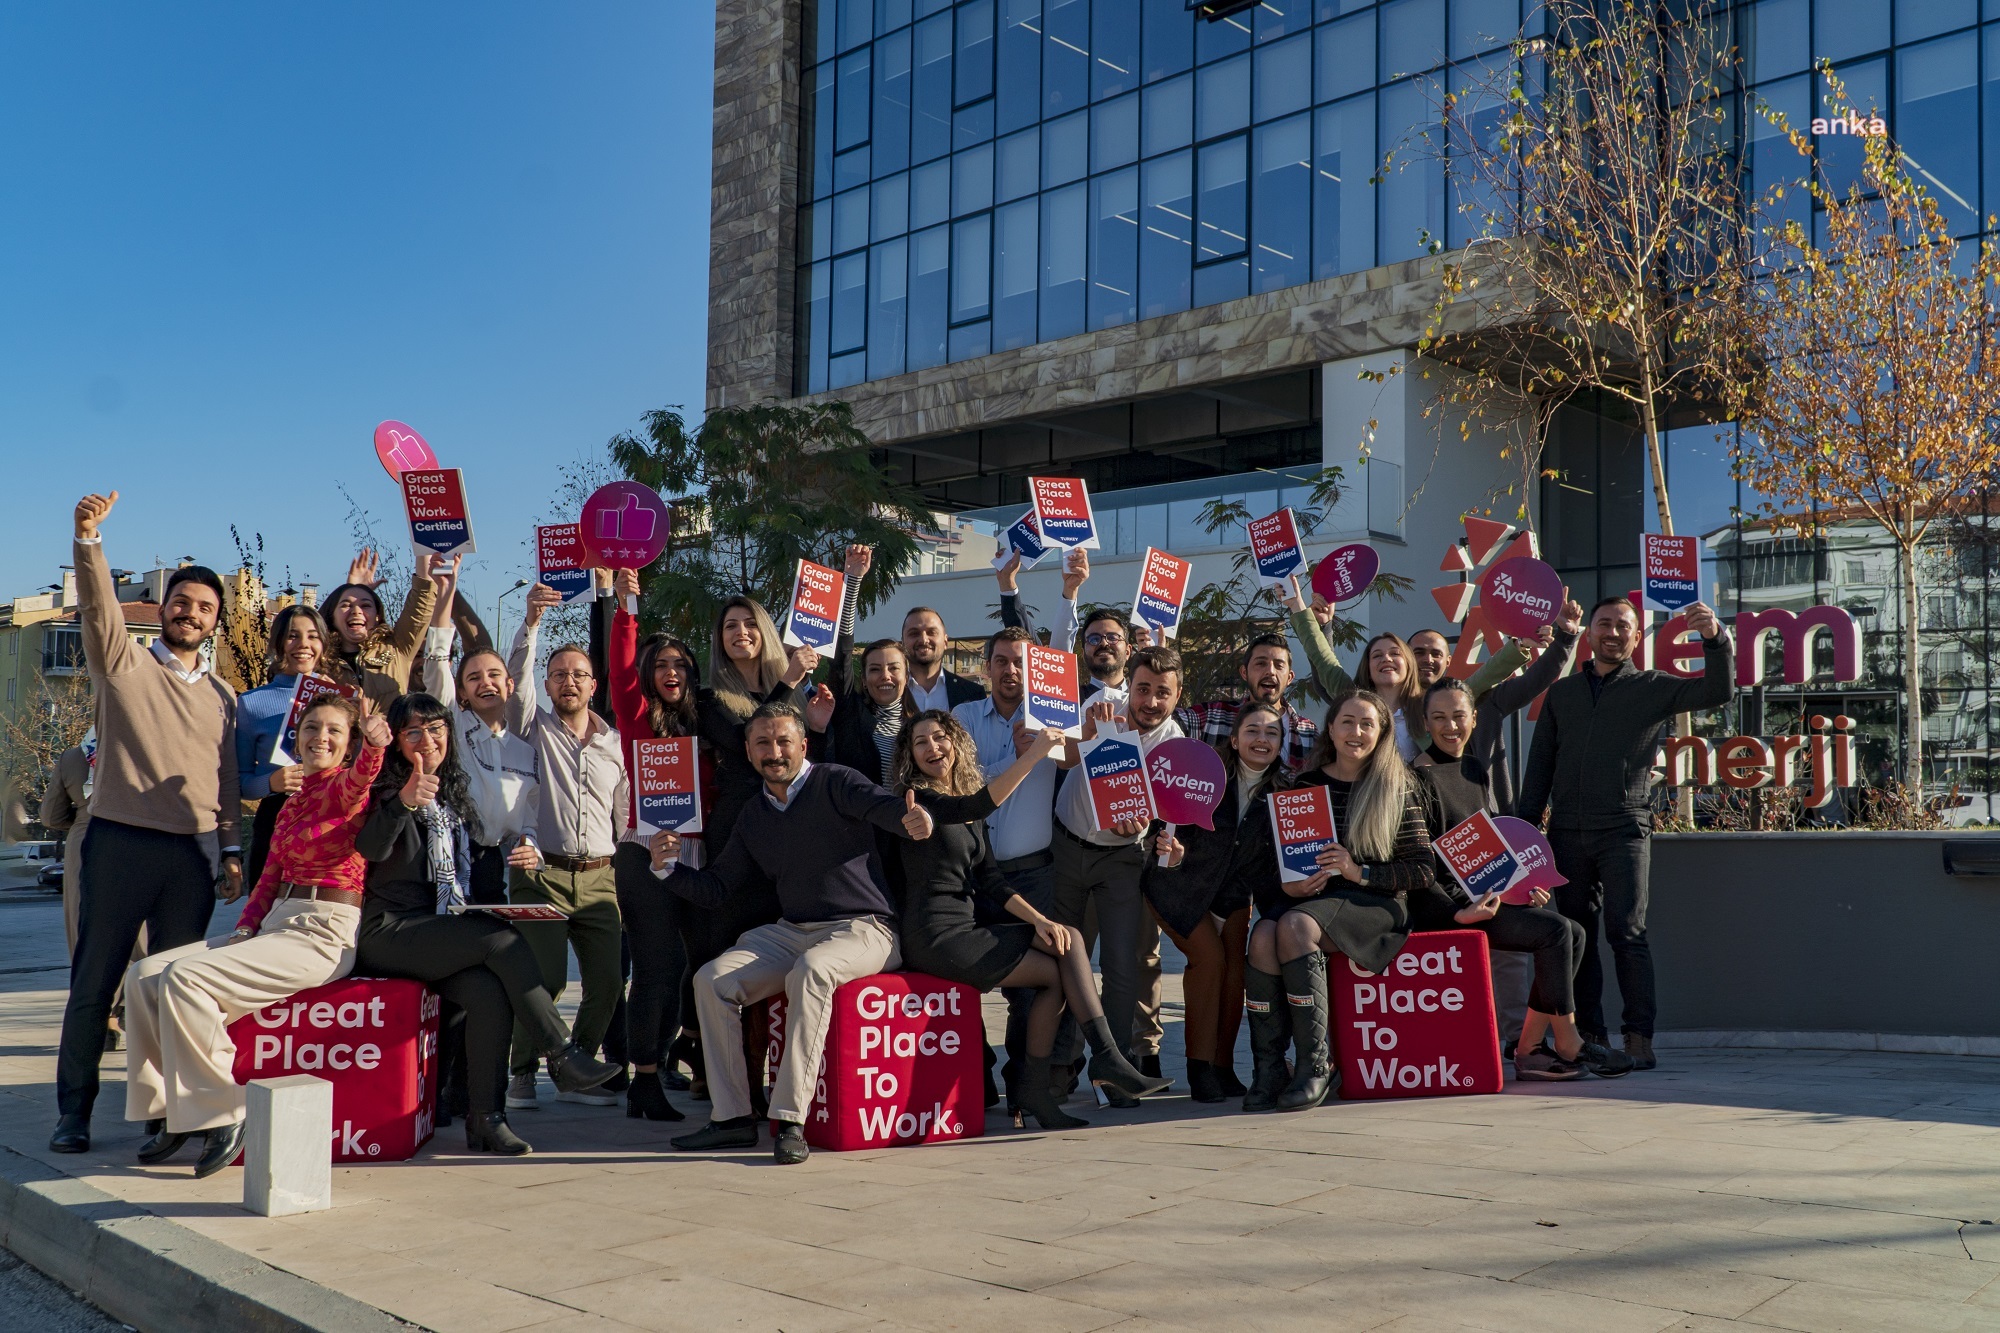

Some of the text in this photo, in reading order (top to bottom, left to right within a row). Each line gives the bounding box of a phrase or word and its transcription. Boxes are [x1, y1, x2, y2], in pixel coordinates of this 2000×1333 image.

[406, 473, 445, 484] Great
[1036, 480, 1071, 489] Great
[409, 485, 446, 494] Place
[1039, 489, 1072, 498] Place
[410, 496, 425, 506] To
[1040, 498, 1054, 506] To
[415, 521, 463, 531] Certified
[1027, 514, 1039, 530] Wo
[1045, 519, 1088, 528] Certified
[1251, 515, 1280, 531] Great
[541, 526, 575, 537] Great
[1254, 525, 1281, 539] Place
[542, 537, 576, 547] Place
[1255, 538, 1266, 547] To
[1648, 536, 1684, 548] Great
[542, 548, 555, 557] To
[1260, 548, 1296, 566] Certified
[1649, 546, 1684, 557] Place
[1151, 552, 1179, 570] Great
[1649, 556, 1662, 566] To
[543, 571, 586, 581] Certified
[804, 564, 834, 582] Great
[1148, 571, 1158, 583] To
[1149, 563, 1176, 580] Place
[1274, 568, 1289, 576] TURKEY
[1335, 557, 1354, 593] Aydem
[802, 575, 831, 593] Place
[1333, 580, 1345, 597] enerji
[1649, 580, 1694, 591] Certified
[800, 586, 811, 597] To
[1492, 584, 1552, 611] Aydem
[1142, 596, 1176, 615] Certified
[1522, 607, 1549, 621] enerji
[795, 612, 833, 631] Certified
[803, 636, 818, 644] TURKEY
[1030, 646, 1064, 663] Great
[1032, 658, 1064, 674] Place
[1031, 668, 1044, 680] To
[1032, 696, 1075, 713] Certified
[1045, 719, 1064, 727] TURKEY
[640, 742, 679, 754] Great
[1100, 744, 1120, 752] TURKEY
[642, 755, 679, 766] Place
[1090, 758, 1138, 776] Certified
[1651, 715, 1856, 808] nerji
[642, 767, 656, 778] To
[1151, 769, 1215, 793] Aydem
[1130, 784, 1145, 795] To
[643, 795, 691, 808] Certified
[1110, 796, 1146, 811] Place
[1184, 791, 1213, 805] enerji
[1276, 792, 1314, 806] Great
[1279, 804, 1315, 817] Place
[1280, 818, 1294, 828] To
[1440, 822, 1475, 849] Great
[1446, 831, 1480, 857] Place
[1452, 854, 1467, 865] To
[1467, 854, 1509, 885] Certified
[1349, 946, 1462, 978] eat
[857, 987, 961, 1020] Great
[1354, 983, 1464, 1014] Place
[252, 996, 385, 1028] Great
[860, 1026, 960, 1059] Place
[1353, 1021, 1398, 1051] To
[254, 1034, 382, 1070] Place
[769, 1000, 782, 1090] Wor
[418, 1072, 424, 1104] To
[857, 1067, 898, 1099] To
